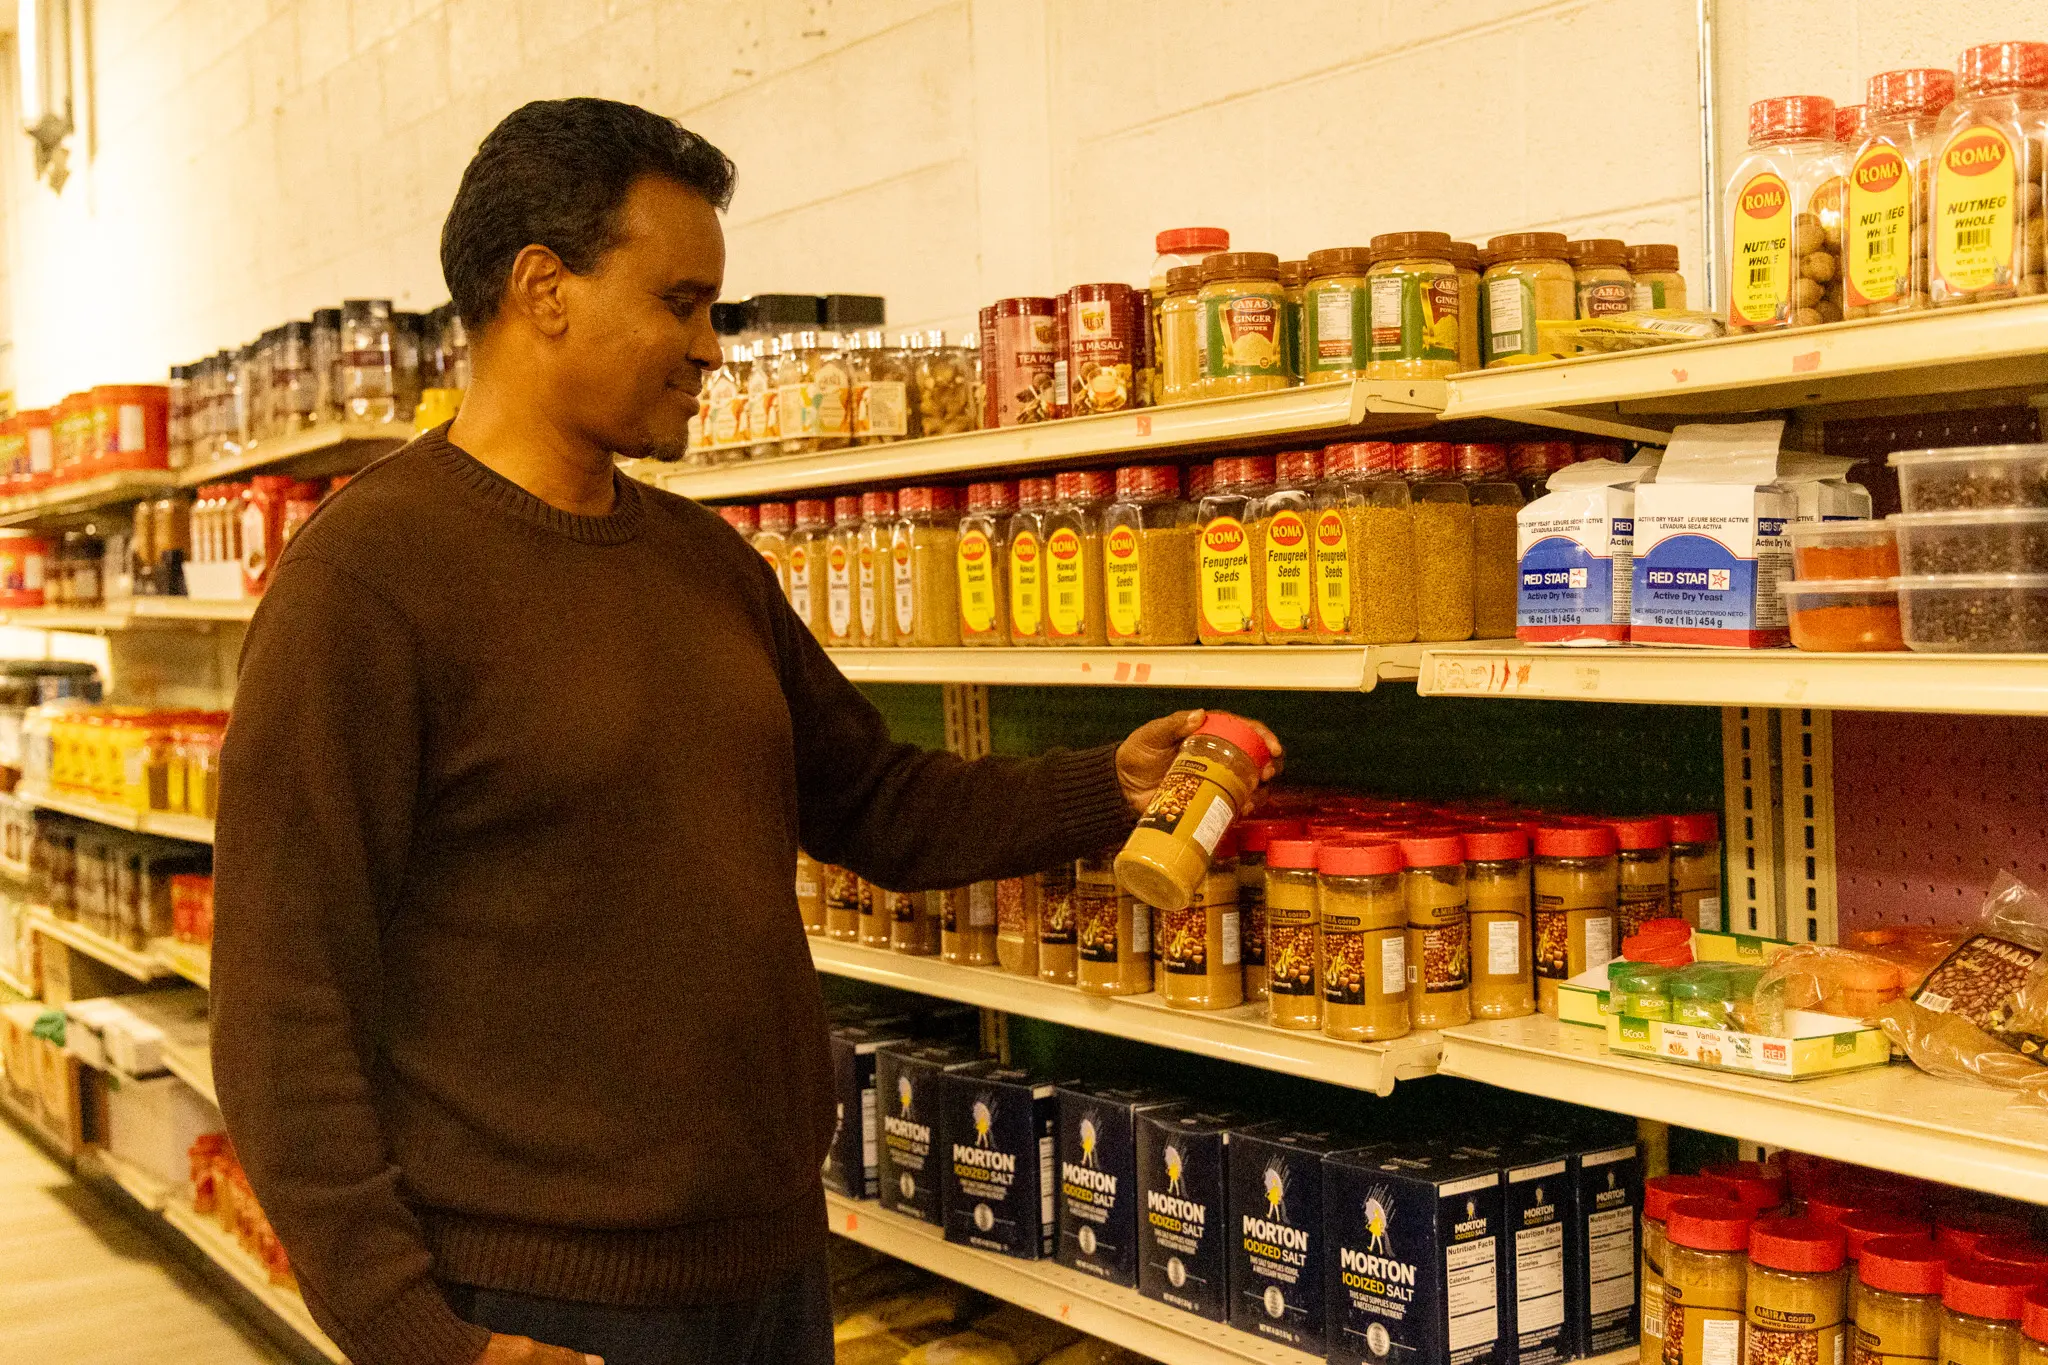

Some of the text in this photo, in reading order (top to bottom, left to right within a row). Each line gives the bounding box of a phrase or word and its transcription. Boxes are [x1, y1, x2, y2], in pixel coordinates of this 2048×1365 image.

[1951, 144, 2001, 167] ROMA
[1859, 161, 1899, 184] ROMA
[1745, 191, 1781, 210] ROMA
[1946, 196, 2007, 215] NUTMEG
[1955, 215, 1996, 228] WHOLE
[1866, 224, 1897, 239] WHLE
[1748, 254, 1779, 266] WHOE
[1599, 287, 1625, 297] ANAS
[1237, 299, 1268, 309] ANAS
[1593, 303, 1628, 311] GINGER
[1233, 315, 1271, 323] GINGER
[1086, 341, 1124, 351] MASALA
[1018, 354, 1037, 363] TEA
[1273, 525, 1302, 538] ROMA
[1320, 524, 1341, 537] ROMA
[1614, 522, 1632, 531] RED
[1760, 522, 1772, 531] RED
[1111, 538, 1133, 551] ROMA
[1207, 531, 1241, 545] ROMA
[1756, 539, 1773, 547] Active
[1775, 540, 1783, 548] Dry
[1052, 541, 1077, 553] ROMA
[1202, 554, 1248, 569] Fenugreek
[1268, 549, 1308, 564] Fenugreek
[1316, 549, 1347, 564] Fenugreek
[1108, 562, 1138, 574] Fenugreek
[1277, 565, 1301, 577] Seeds
[1325, 565, 1343, 578] Seeds
[1116, 576, 1133, 587] Seeds
[1213, 570, 1240, 583] Seeds
[1524, 572, 1568, 586] RED STAR
[1649, 572, 1707, 584] RED STAR
[1527, 591, 1580, 601] Active Dry Yeas
[1653, 592, 1723, 602] Active Dry Yeast
[1528, 615, 1535, 623] 16
[1562, 614, 1575, 623] 454
[1576, 616, 1581, 624] g
[1655, 616, 1662, 624] 16
[1699, 618, 1715, 626] 454
[1717, 620, 1723, 628] g
[1683, 1008, 1709, 1018] BCO
[1696, 1031, 1721, 1041] Vanilla
[1765, 1049, 1785, 1060] RED
[885, 1116, 930, 1144] MORTON
[953, 1144, 1015, 1173] MORTON
[990, 1171, 1014, 1185] SALT
[1063, 1162, 1116, 1194] MORTON
[1093, 1193, 1115, 1208] SALT
[1596, 1188, 1625, 1202] MORTON
[1148, 1190, 1205, 1224] MORTON
[1524, 1204, 1554, 1219] MORTON
[1590, 1212, 1616, 1223] Nutrition
[1149, 1213, 1204, 1238] IODIZED SALT
[1455, 1218, 1486, 1233] MORTON
[1475, 1228, 1486, 1236] SALT
[1243, 1215, 1308, 1252] MORTON
[1517, 1226, 1561, 1240] Nutrition Facts
[1244, 1238, 1306, 1266] IODIZED SALT
[1448, 1240, 1494, 1255] Nutrition Facts
[1341, 1248, 1415, 1286] MORTON
[1490, 1266, 1495, 1274] 0
[1518, 1260, 1539, 1268] Calories
[1449, 1275, 1470, 1284] Calories
[1342, 1272, 1414, 1302] IODIZED SALT
[1349, 1290, 1359, 1299] THIS
[1359, 1292, 1368, 1301] SALT
[1369, 1295, 1389, 1306] SUPPLIES
[1353, 1299, 1403, 1320] A NECESSARY NUTRIENT
[1756, 1307, 1814, 1324] AMIRA COFFEE
